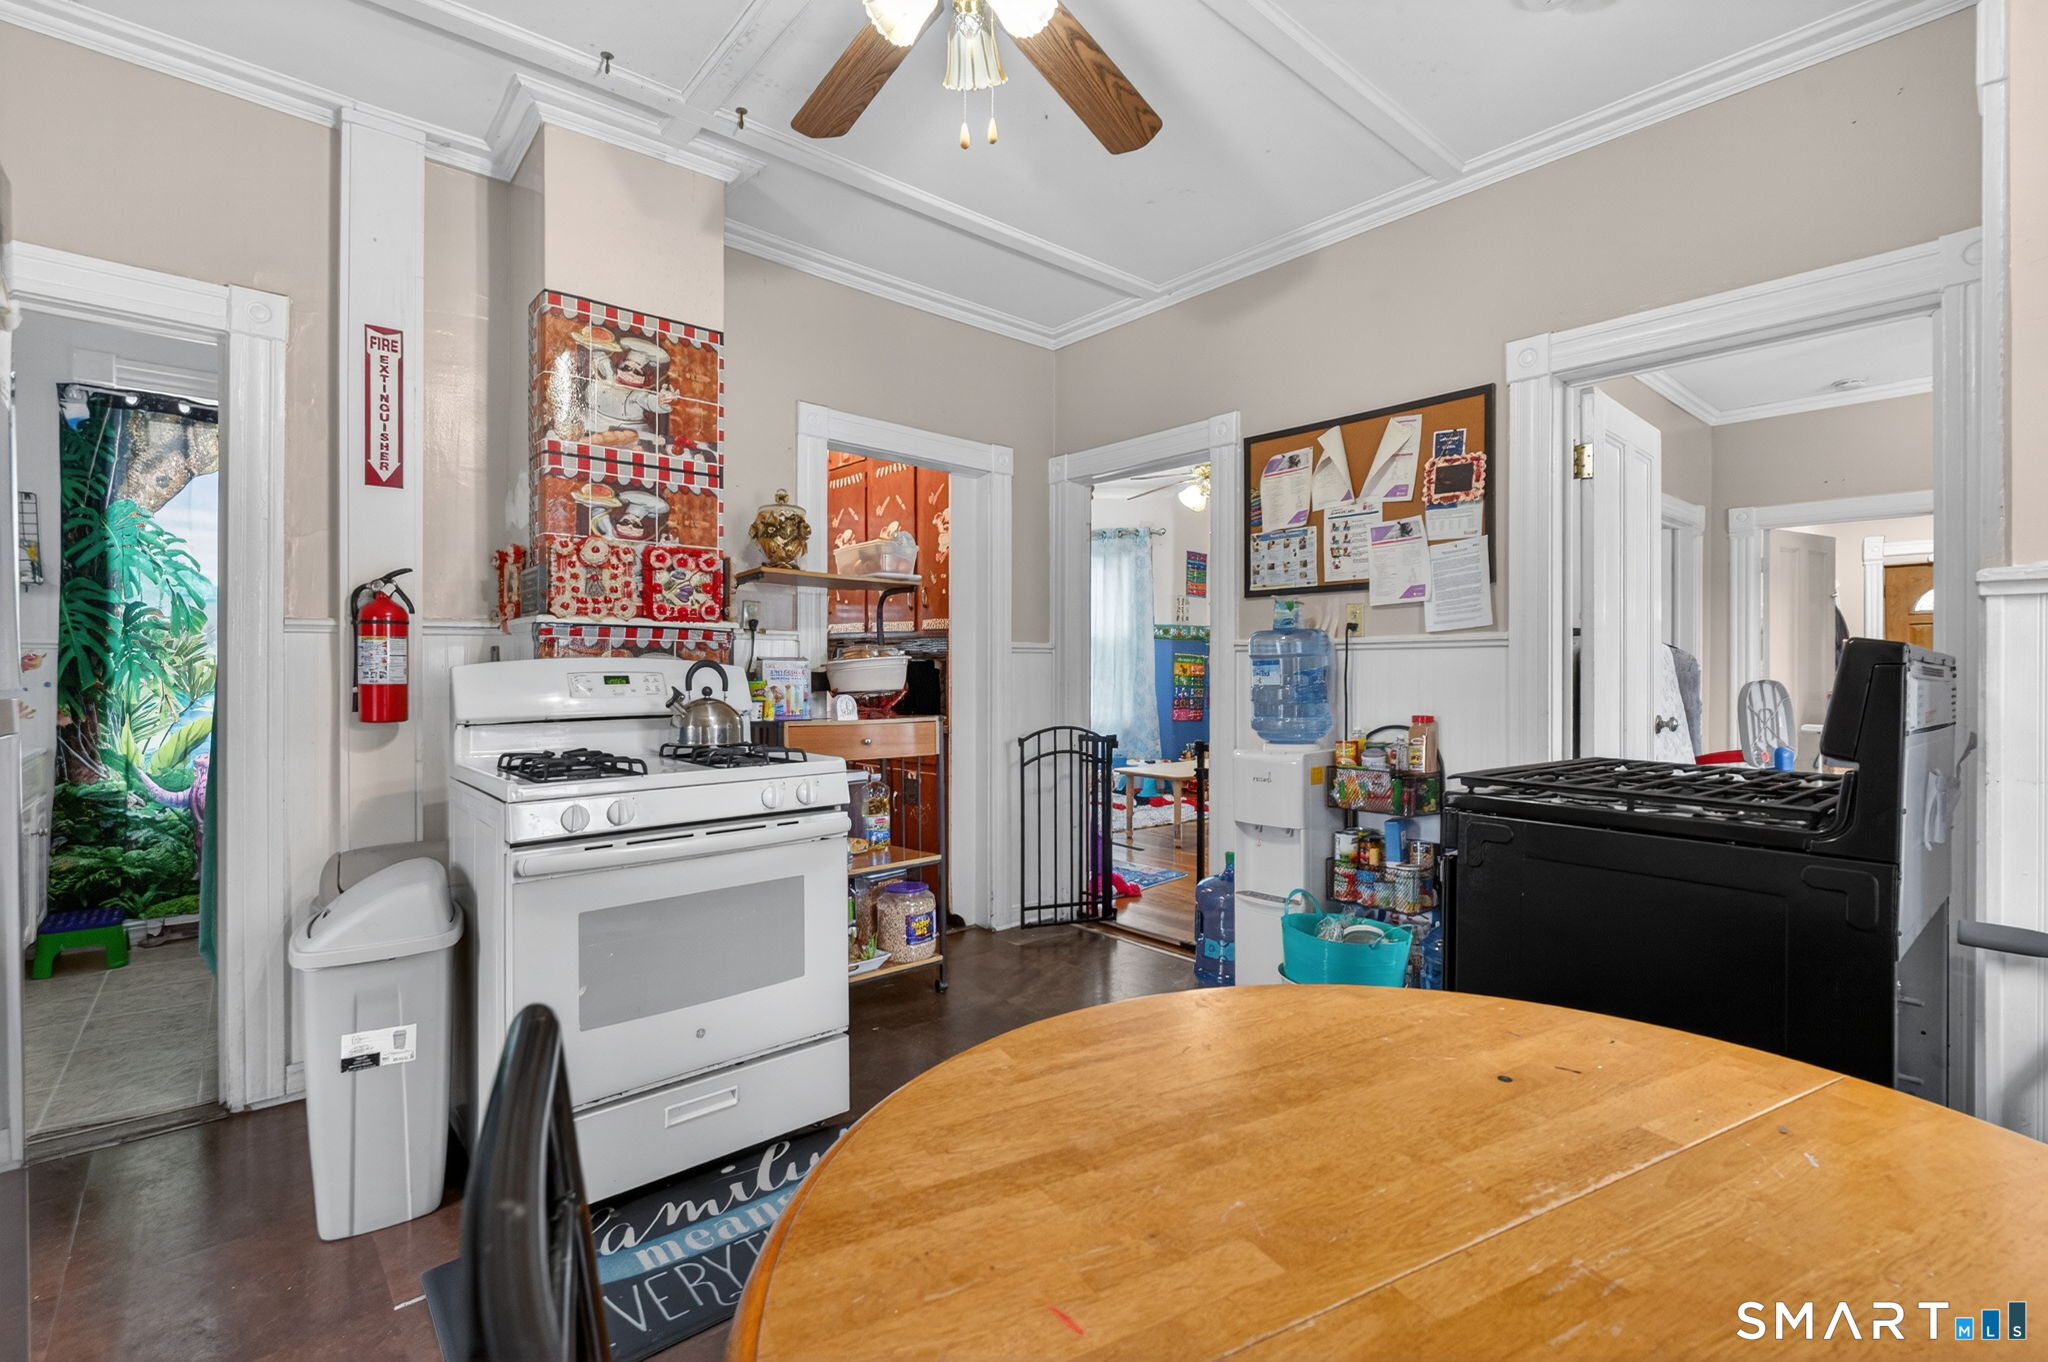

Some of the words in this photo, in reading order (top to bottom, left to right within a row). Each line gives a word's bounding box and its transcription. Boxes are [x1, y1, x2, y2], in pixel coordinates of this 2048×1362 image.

[370, 336, 399, 353] FIRE
[379, 355, 390, 471] EXTINGUISHER
[635, 1192, 793, 1271] mean
[603, 1230, 769, 1332] VERYT
